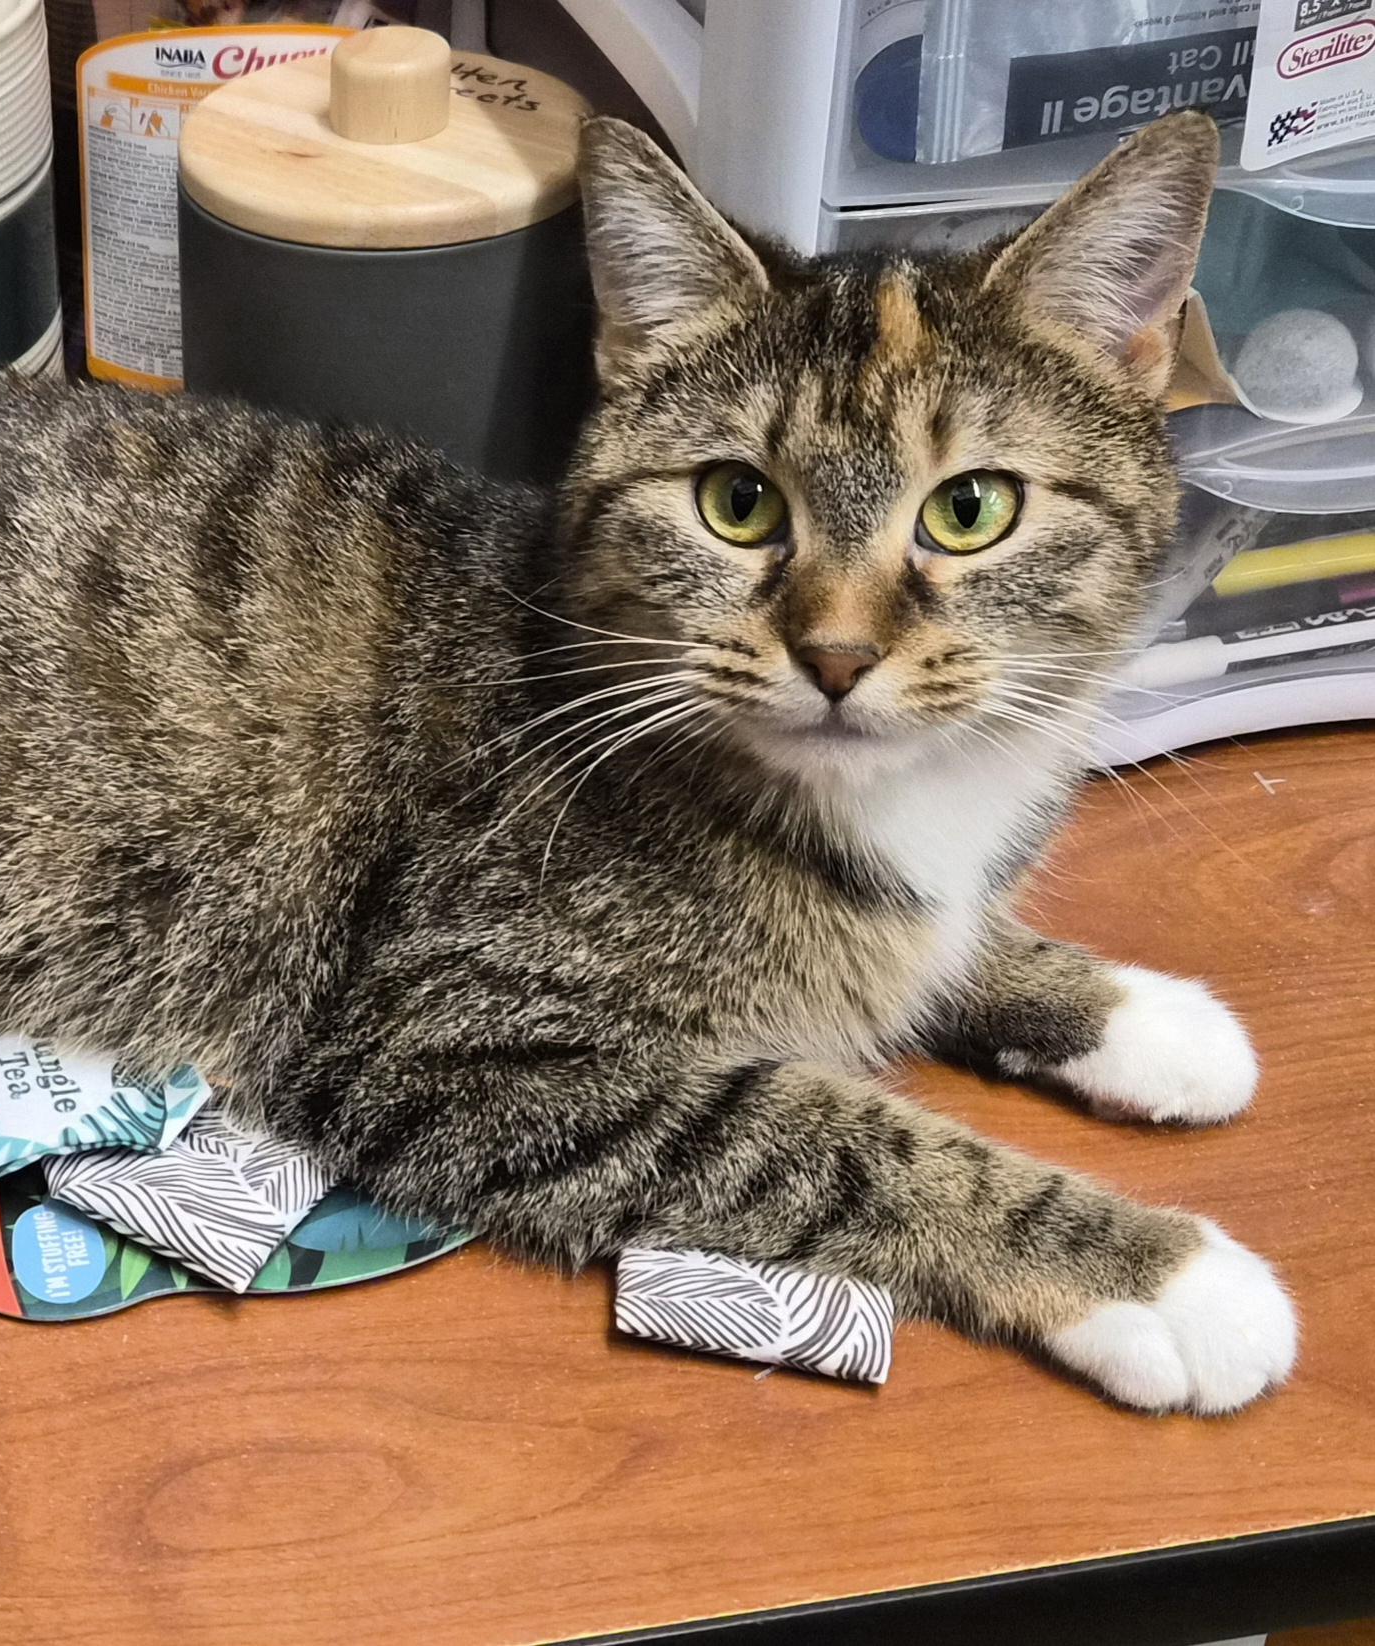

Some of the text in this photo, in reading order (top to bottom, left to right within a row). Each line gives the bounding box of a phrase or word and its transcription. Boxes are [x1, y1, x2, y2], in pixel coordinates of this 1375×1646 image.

[154, 45, 206, 65] INABA
[1166, 44, 1223, 75] Cat
[1287, 32, 1367, 73] Sterilite
[1072, 73, 1248, 123] vantage
[33, 1040, 82, 1114] ungle
[33, 1211, 71, 1299] I'M STUFFING
[60, 1228, 91, 1269] FREE!
